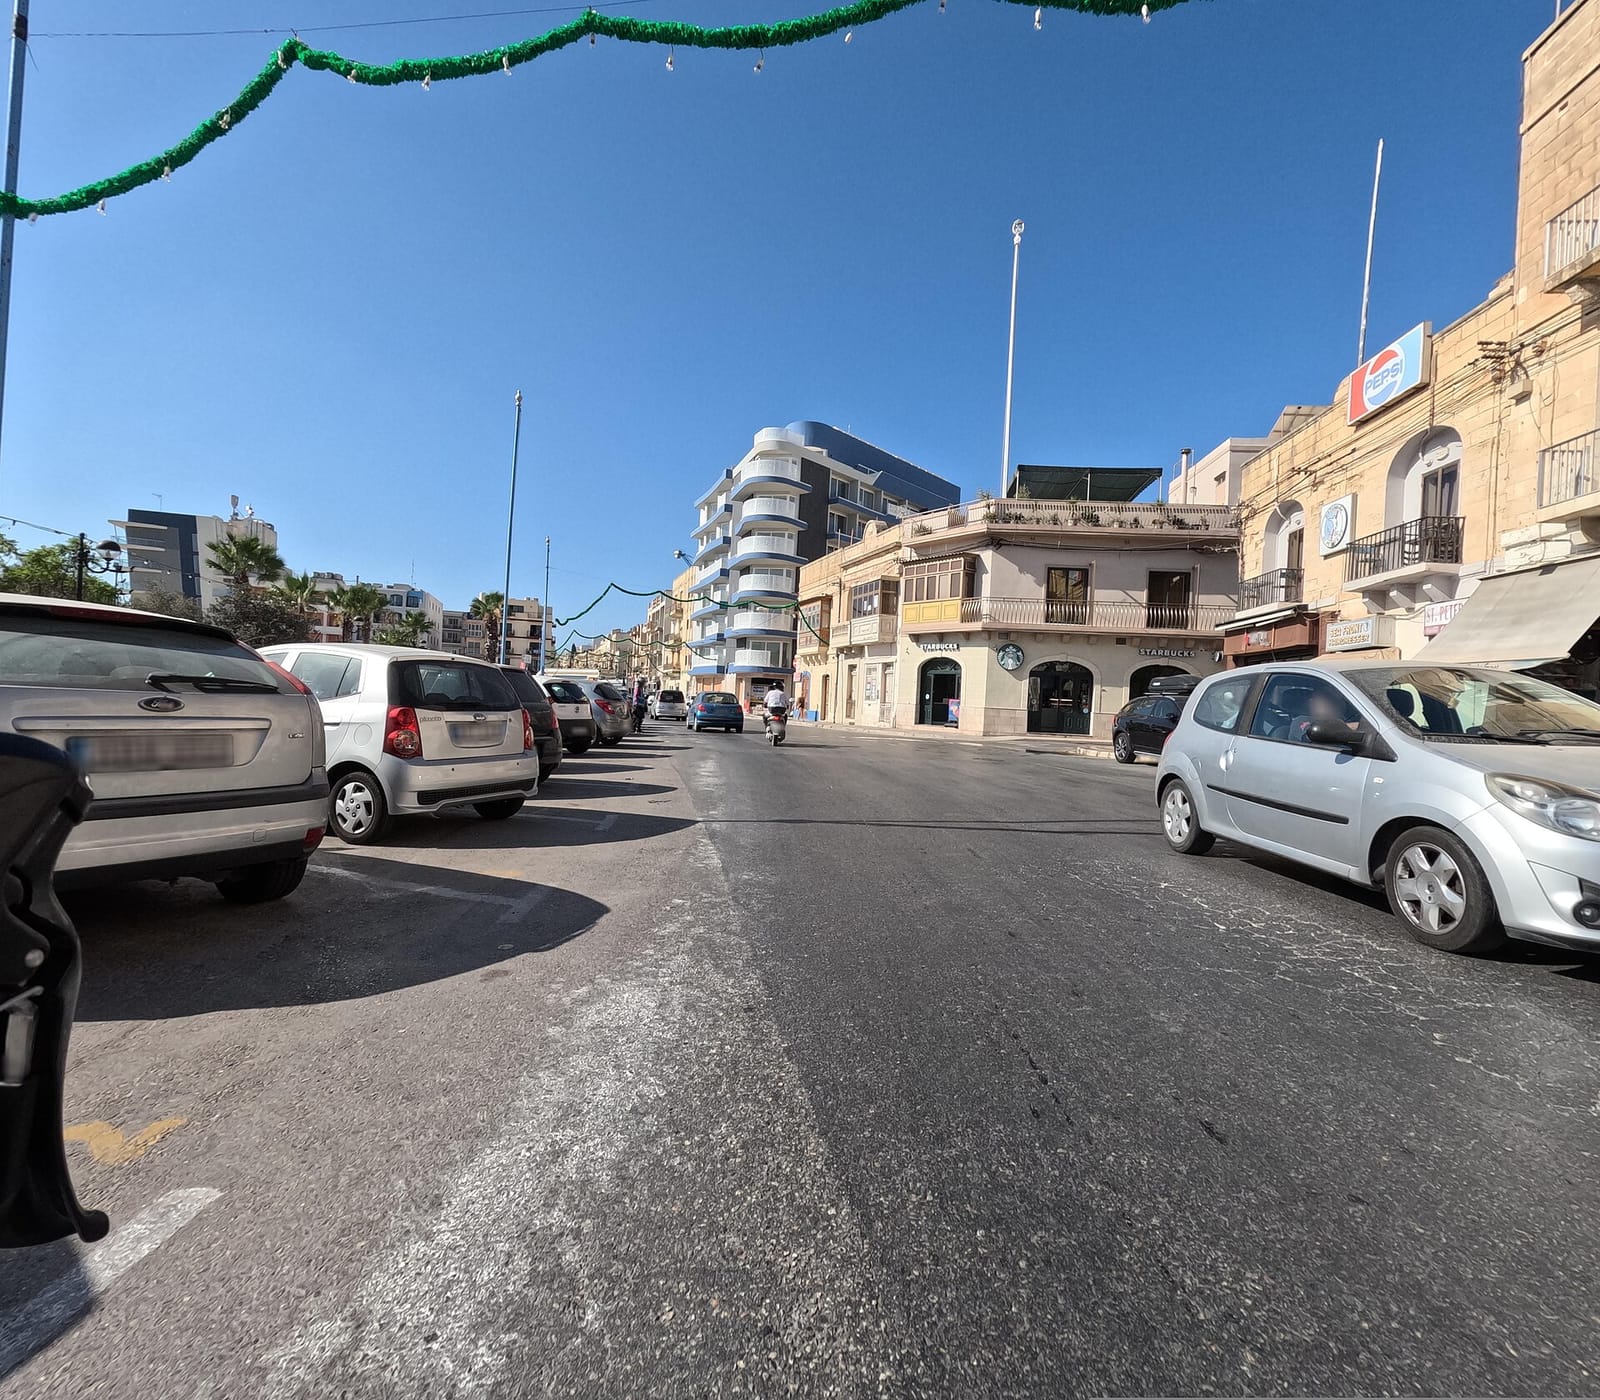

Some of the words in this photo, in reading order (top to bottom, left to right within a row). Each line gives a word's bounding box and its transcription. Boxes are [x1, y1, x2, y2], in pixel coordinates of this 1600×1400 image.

[1366, 358, 1403, 395] PEPSI
[920, 643, 958, 651] STARBUCKS
[1139, 648, 1196, 658] STARBUCKS
